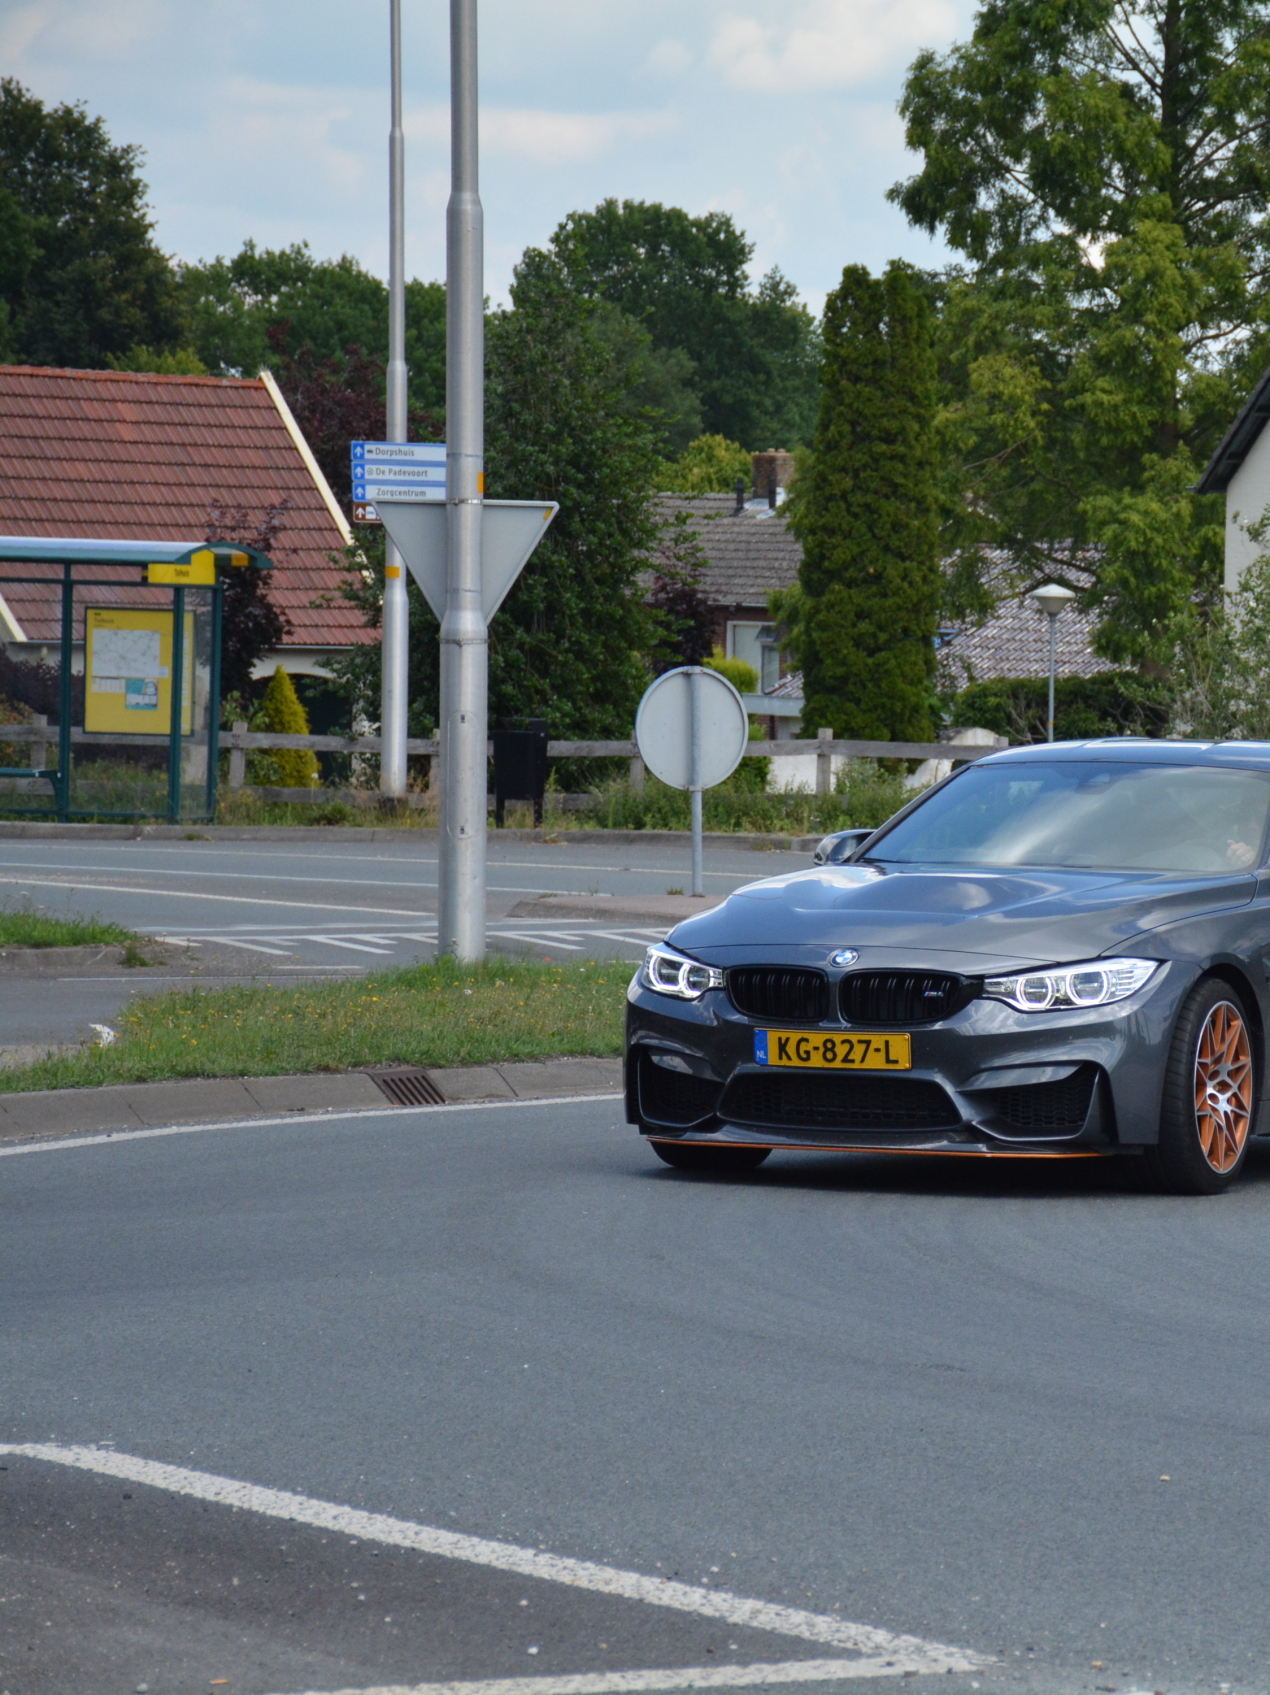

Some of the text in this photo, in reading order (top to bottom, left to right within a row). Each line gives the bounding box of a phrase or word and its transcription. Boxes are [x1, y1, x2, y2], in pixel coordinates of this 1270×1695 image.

[375, 447, 415, 457] Dorpshuis
[388, 468, 428, 477] Padevoort
[376, 488, 427, 497] Zorgcentrum
[757, 1050, 767, 1059] NL
[778, 1036, 899, 1064] KG-827-L
